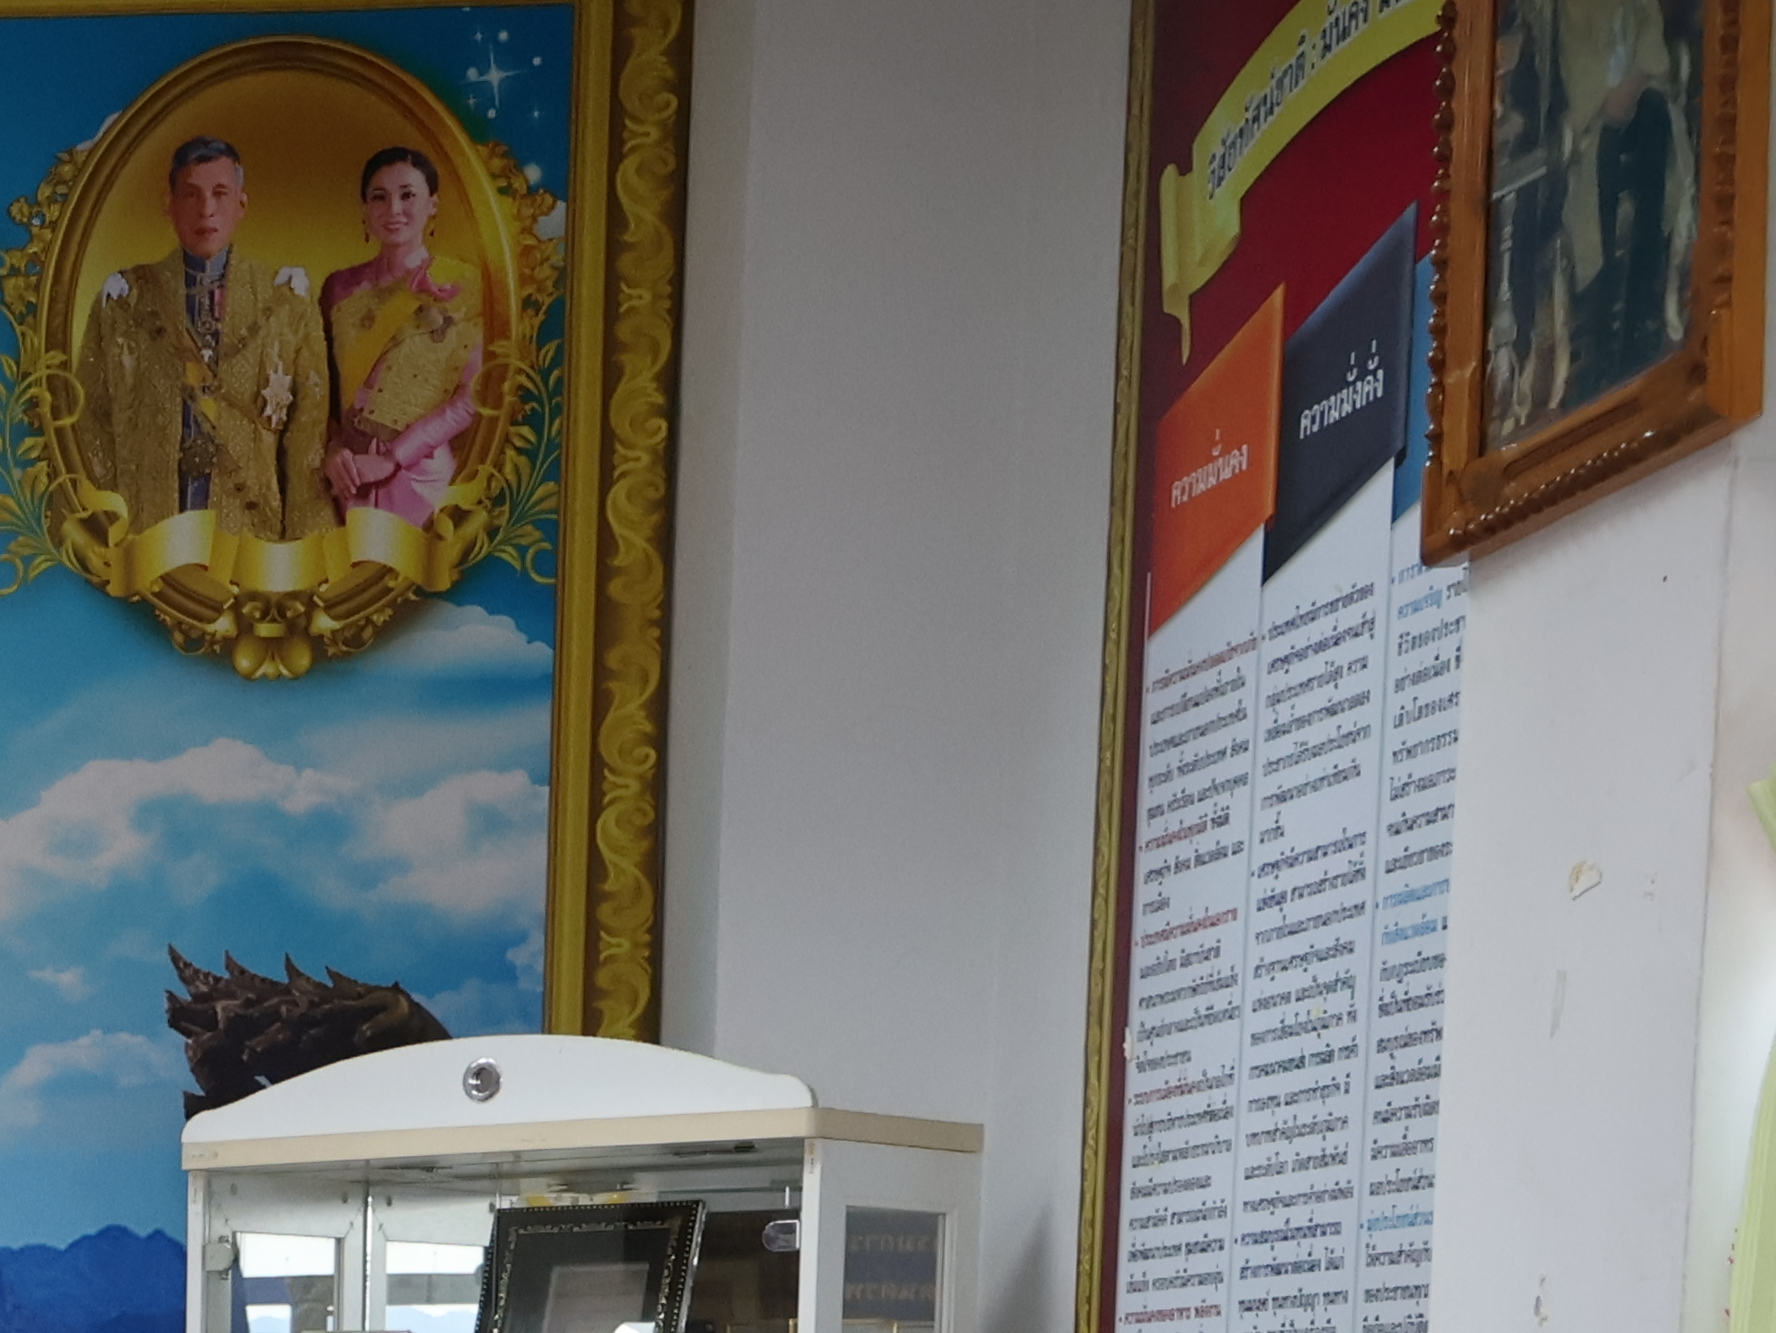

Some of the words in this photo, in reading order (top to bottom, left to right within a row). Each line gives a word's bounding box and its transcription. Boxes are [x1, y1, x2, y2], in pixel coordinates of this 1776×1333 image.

[1299, 340, 1385, 441] ความมั่งคั่ง
[1171, 430, 1248, 508] ความมั่นคง
